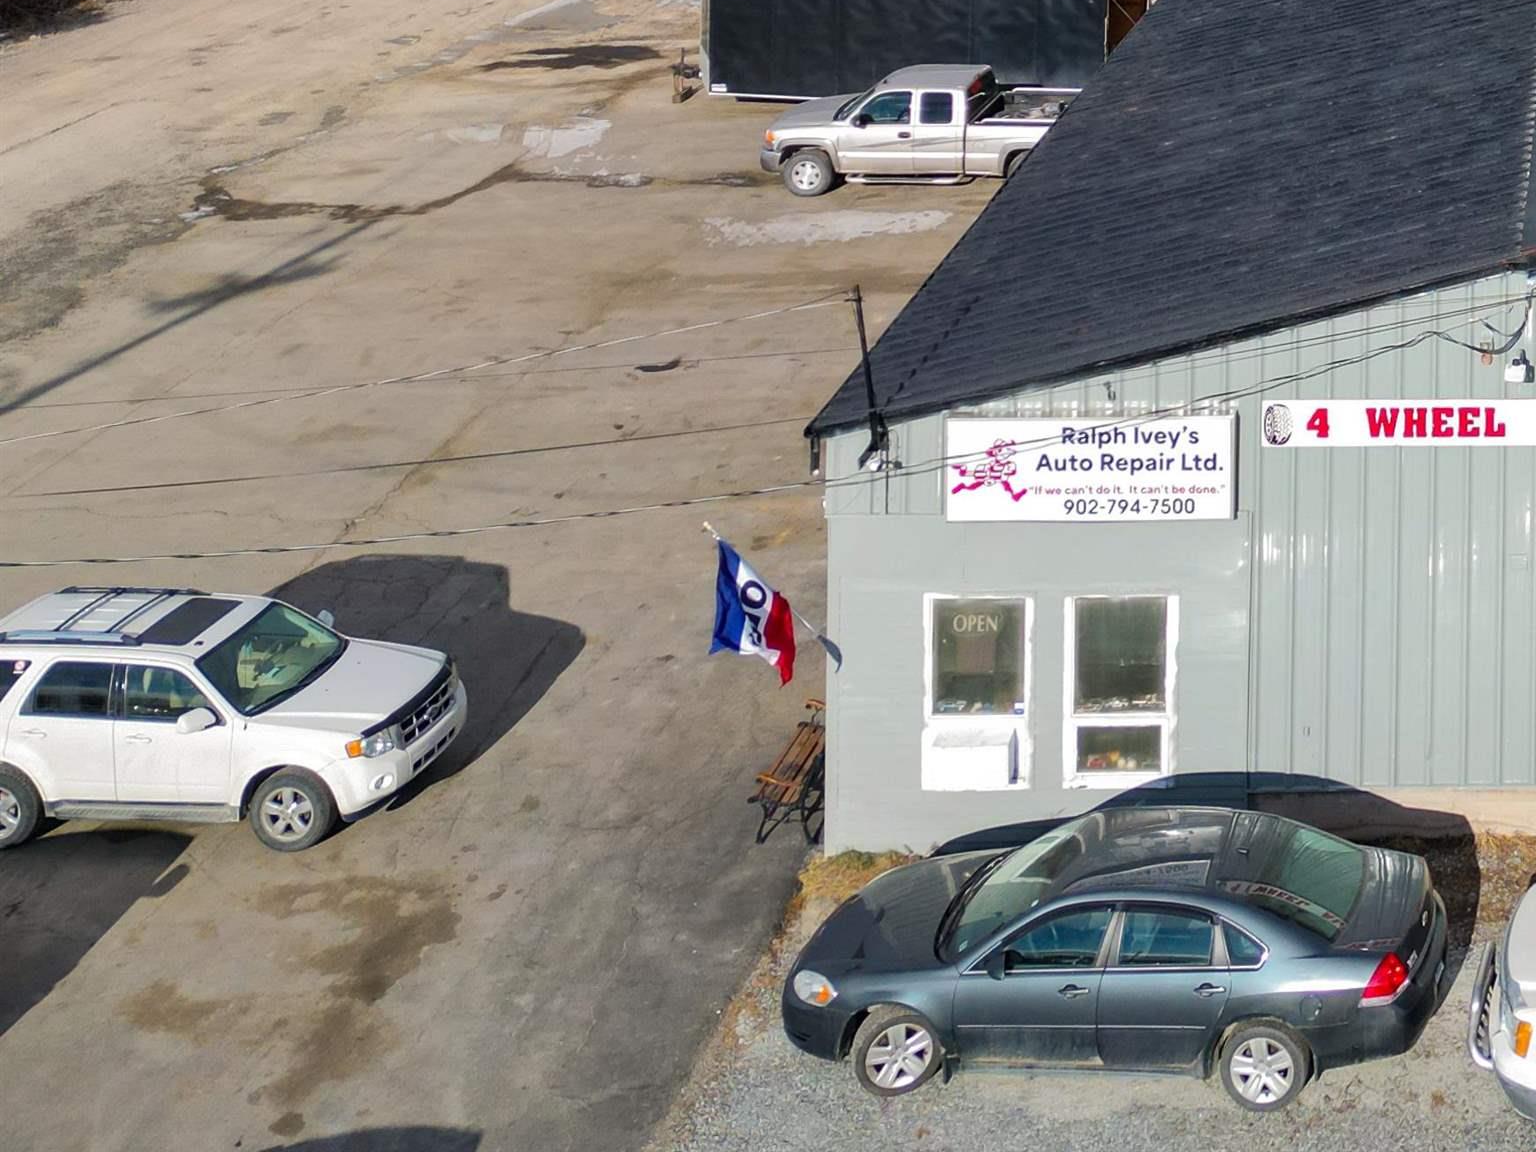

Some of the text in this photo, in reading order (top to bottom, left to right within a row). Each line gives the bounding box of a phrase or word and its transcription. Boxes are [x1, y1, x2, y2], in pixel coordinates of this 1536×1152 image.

[1306, 408, 1330, 438] 4
[1365, 407, 1506, 438] WHEEL
[1061, 425, 1200, 449] Ralph Ivey's
[1036, 452, 1224, 476] Auto Repair Ltd.
[1045, 487, 1062, 495] we
[1064, 485, 1093, 495] can't
[1096, 485, 1111, 495] do
[1140, 485, 1169, 495] can't
[1172, 485, 1186, 494] be
[1063, 498, 1196, 516] 902-794-7500
[952, 614, 999, 633] OPEN
